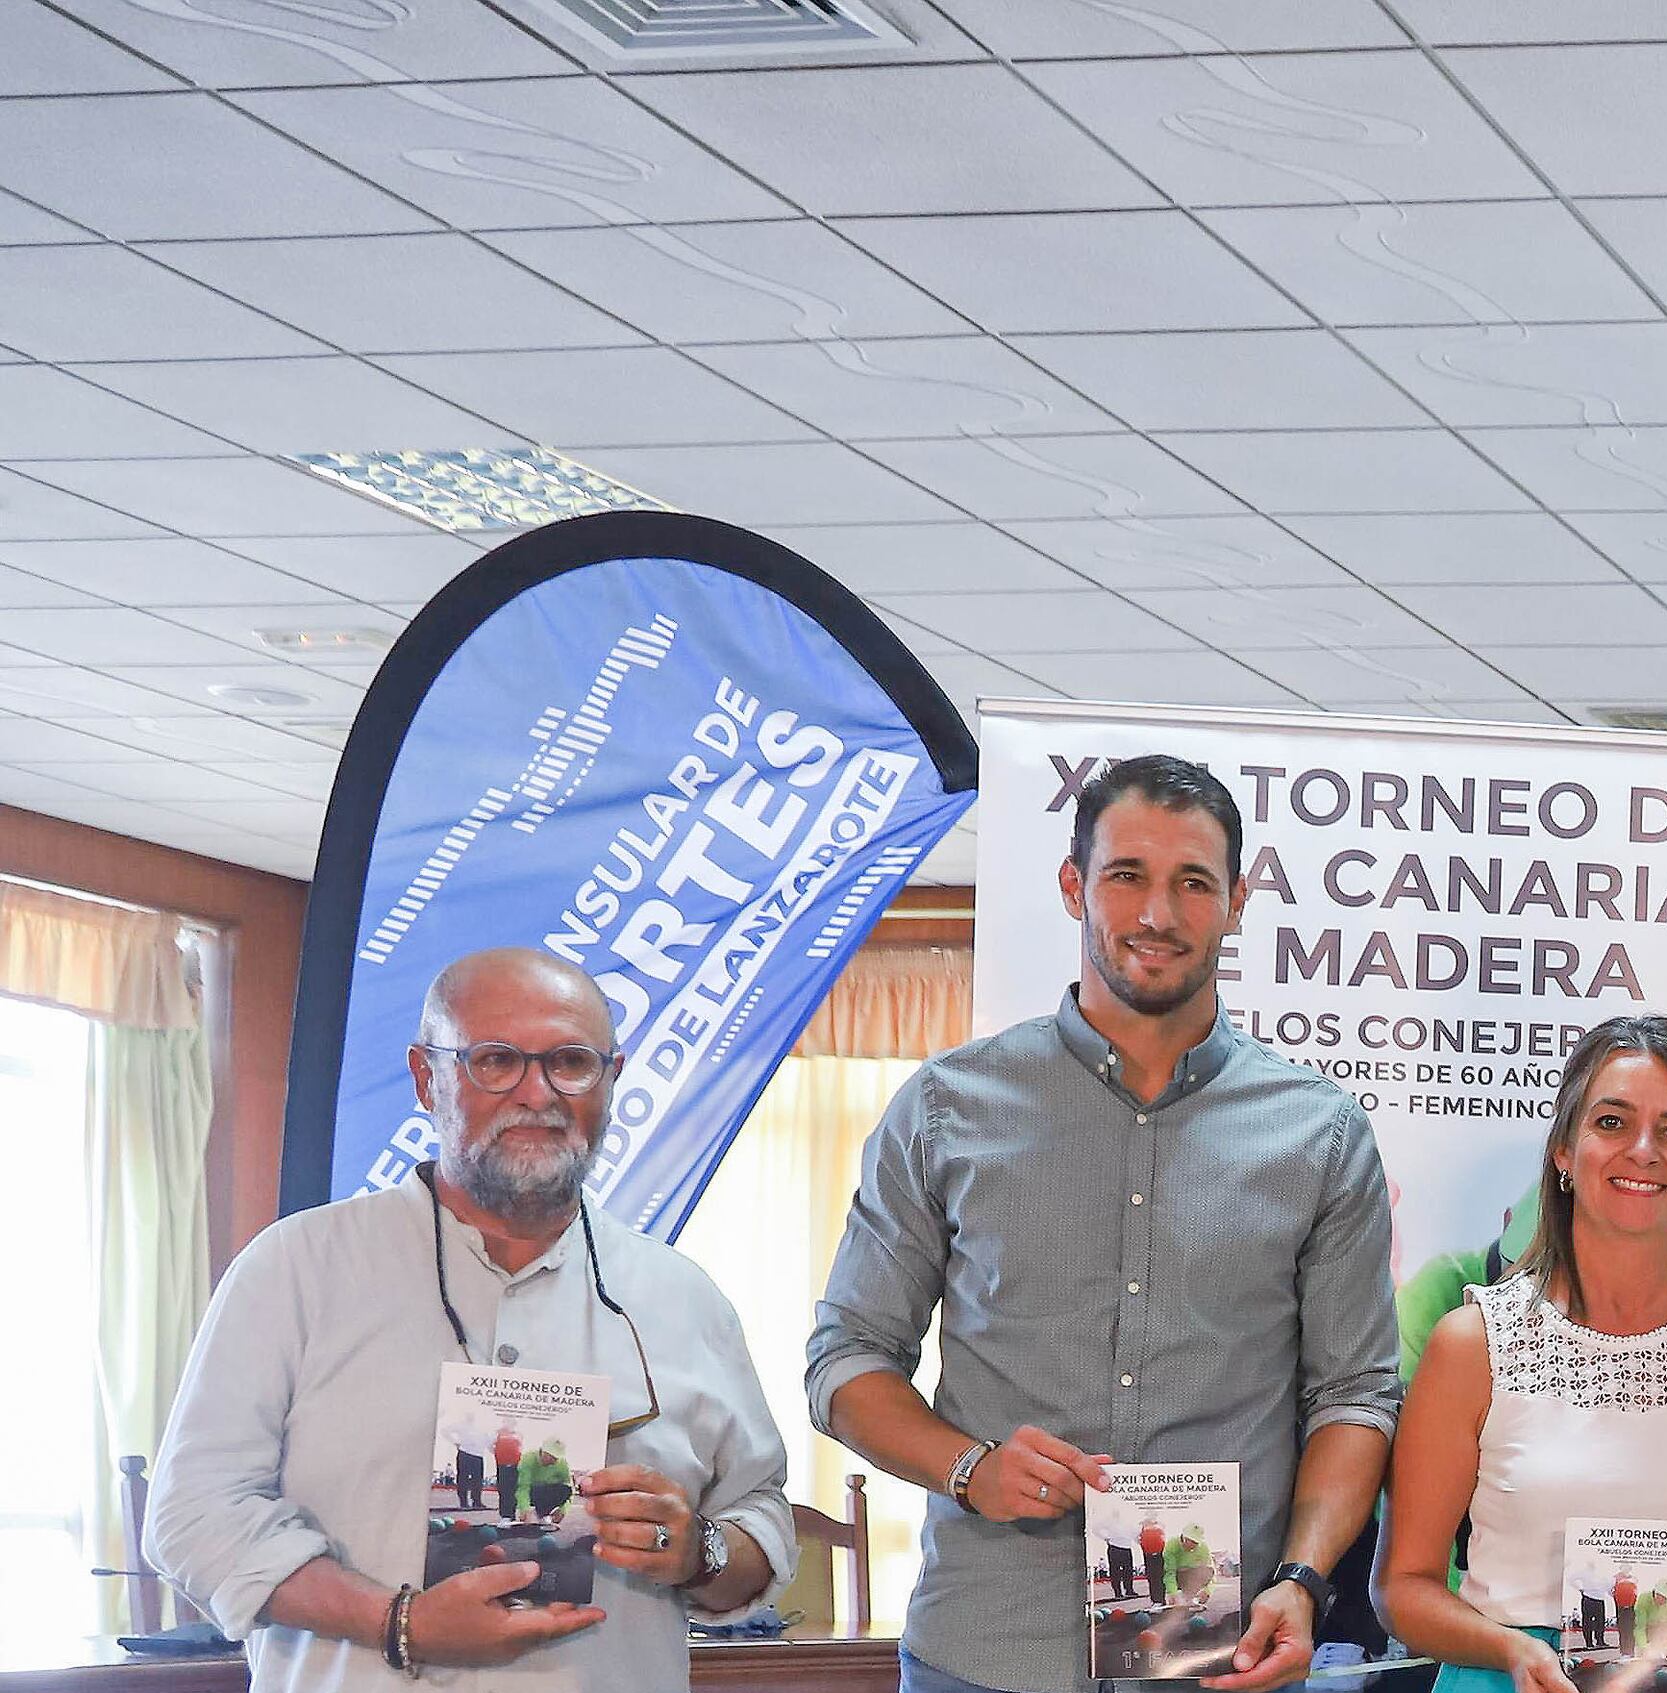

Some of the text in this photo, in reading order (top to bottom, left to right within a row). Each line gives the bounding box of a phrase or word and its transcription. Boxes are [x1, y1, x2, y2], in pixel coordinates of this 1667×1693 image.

[1241, 765, 1598, 839] TORNEO
[543, 754, 719, 964] NSULAR
[692, 675, 762, 760] DE
[594, 710, 845, 1046] ORTES
[657, 755, 901, 1084] DE LANZAROTE
[1216, 926, 1646, 1001] E MADERA
[1358, 1014, 1587, 1057] CONEJER
[1416, 1063, 1451, 1084] DE
[1461, 1065, 1493, 1085] 60
[1502, 1062, 1562, 1088] AÑO
[1409, 1094, 1556, 1119] FEMENINO
[470, 1376, 583, 1397] XXII TORNEO DE
[1107, 1485, 1126, 1493] OLA
[1113, 1474, 1213, 1484] XXII TORNEO DE
[1590, 1528, 1614, 1538] XXII
[1618, 1529, 1667, 1540] TORNEO
